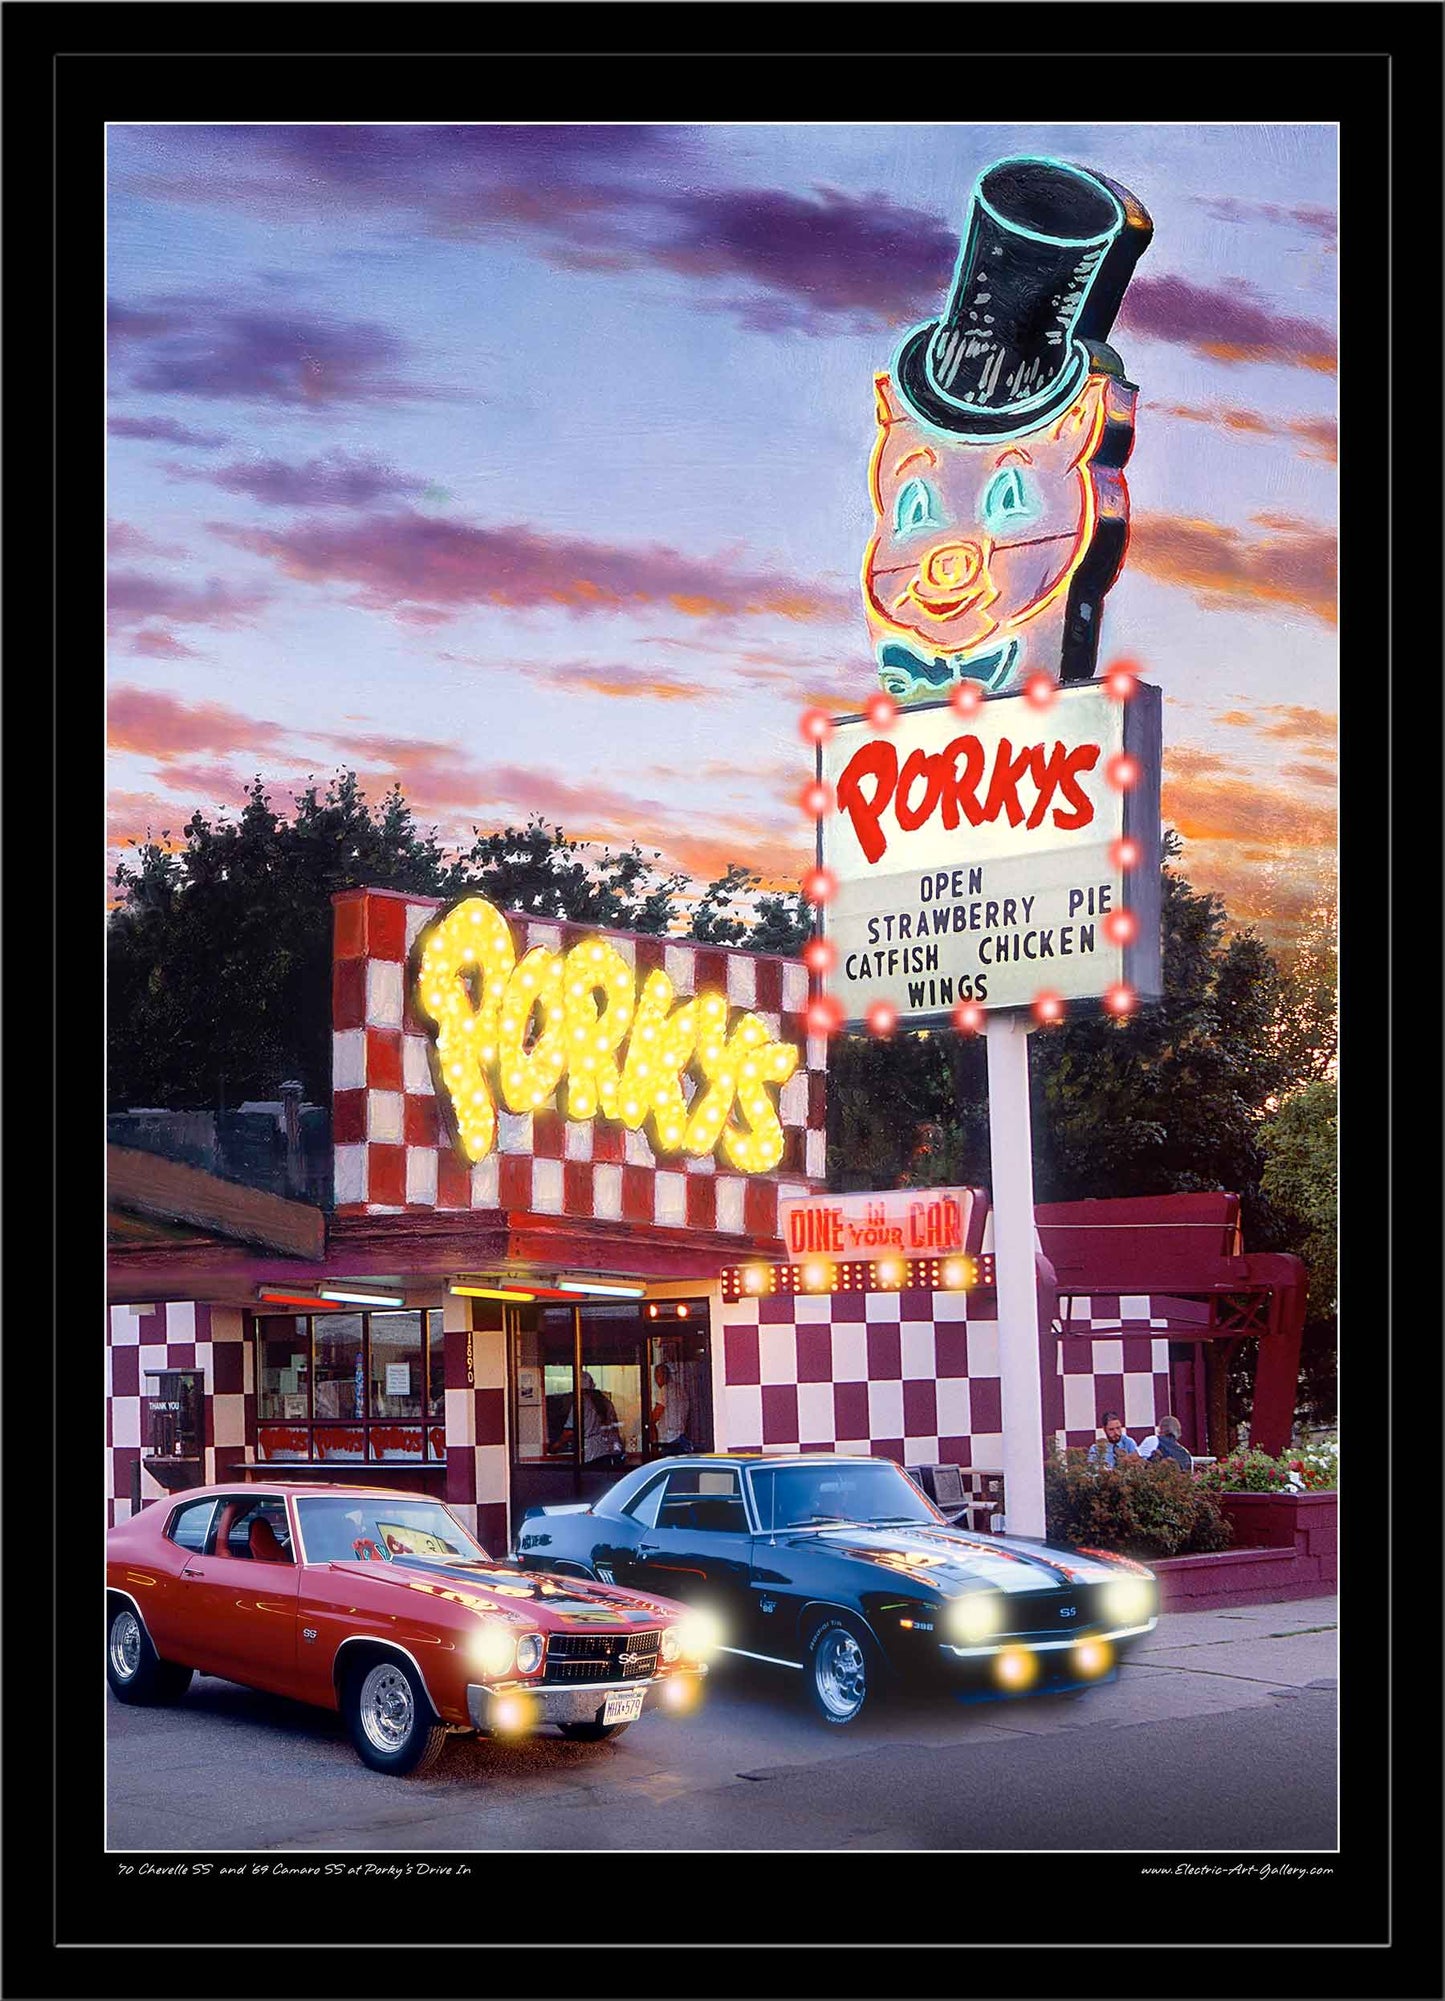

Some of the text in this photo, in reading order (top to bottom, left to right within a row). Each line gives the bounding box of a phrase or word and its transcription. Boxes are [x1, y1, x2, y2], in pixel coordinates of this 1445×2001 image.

[836, 734, 1101, 864] PORKYS
[920, 867, 982, 902] OPEN
[867, 885, 1111, 944] STRAWBERRY PIE
[845, 924, 1095, 980] CATFISH CHICKEN
[908, 974, 988, 1008] WINGS
[418, 896, 799, 1174] PORKYS
[790, 1208, 844, 1253] DINE
[849, 1227, 903, 1247] YOUR
[910, 1199, 961, 1248] CAR
[149, 1402, 180, 1410] THANK YOU
[1060, 1606, 1077, 1618] SS
[303, 1628, 318, 1639] SS
[618, 1652, 638, 1665] SS
